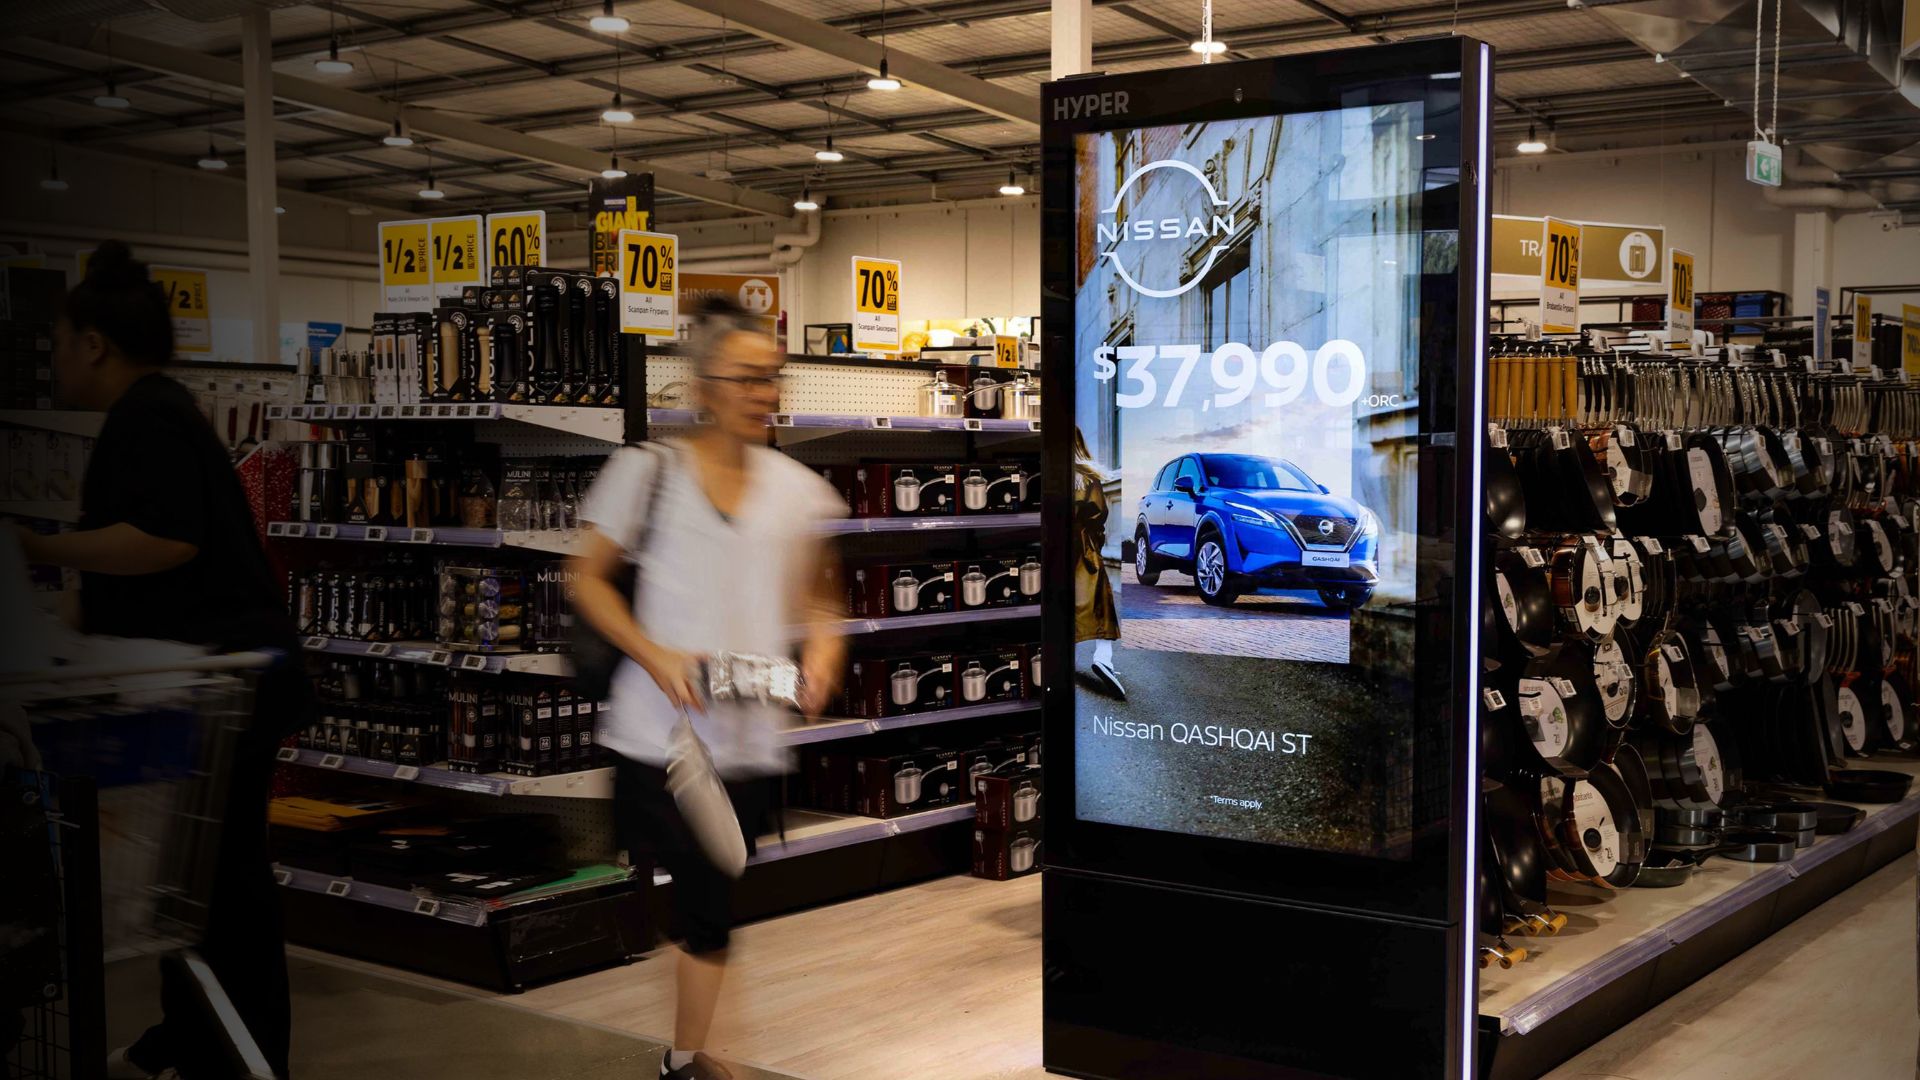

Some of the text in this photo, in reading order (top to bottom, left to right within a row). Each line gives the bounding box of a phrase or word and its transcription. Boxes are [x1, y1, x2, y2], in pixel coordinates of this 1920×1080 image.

[1053, 91, 1129, 120] HYPER
[595, 211, 649, 232] GIANT
[1097, 214, 1235, 243] NISSAN
[385, 238, 415, 274] 1/2
[434, 234, 464, 271] 1/2
[1093, 339, 1399, 412] $37,990 +ORC
[537, 572, 580, 583] MULINI
[448, 690, 478, 704] MULINI
[1093, 715, 1312, 755] Nissan QASHQAI ST
[1239, 799, 1263, 810] apply.
